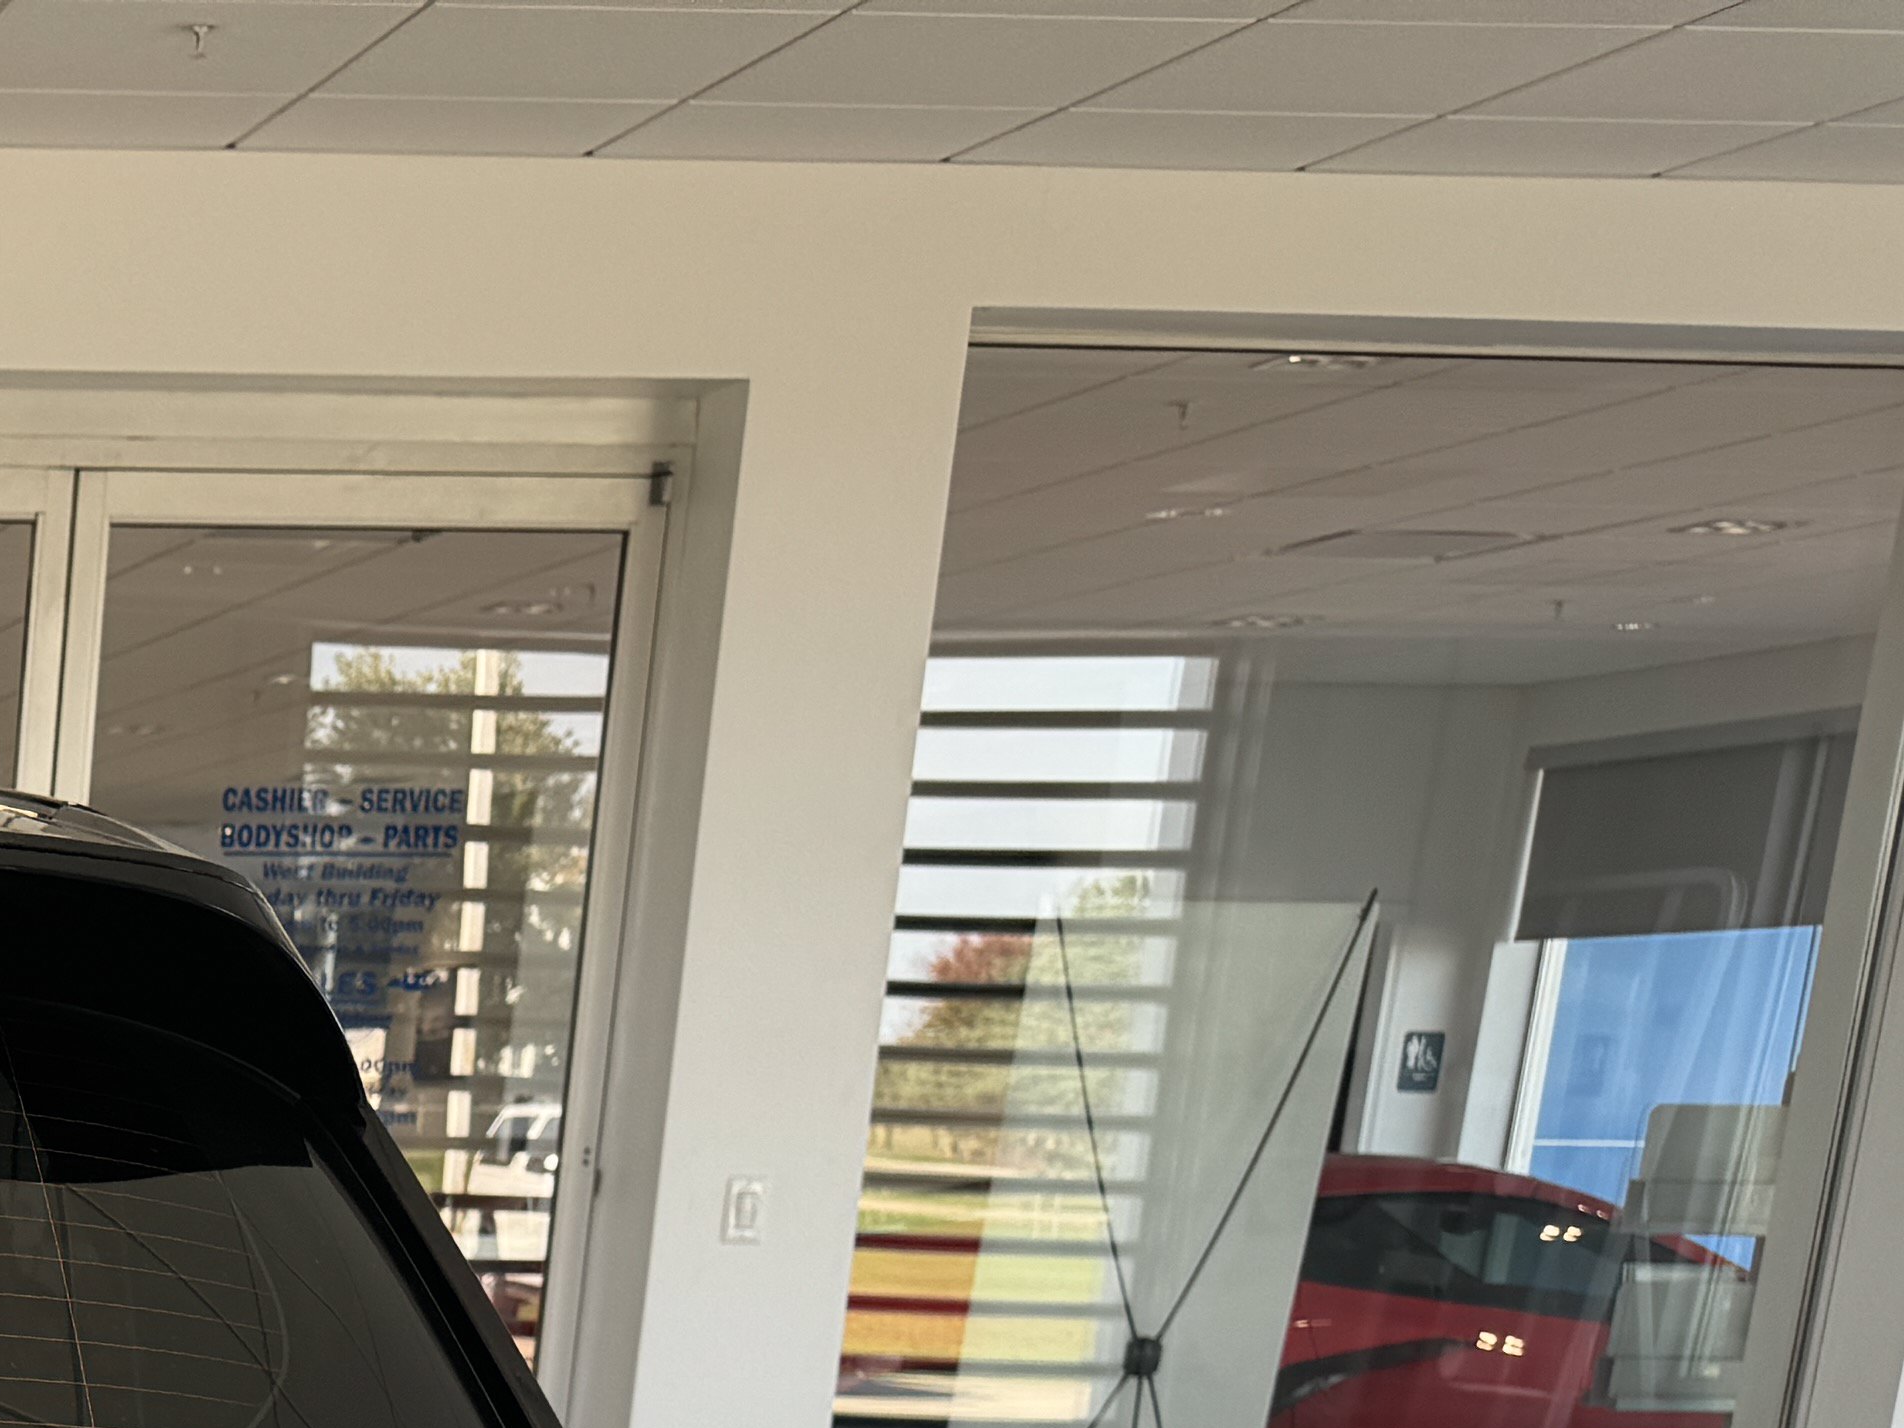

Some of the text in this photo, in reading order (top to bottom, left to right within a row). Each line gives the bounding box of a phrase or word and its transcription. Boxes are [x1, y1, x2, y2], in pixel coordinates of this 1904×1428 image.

[222, 786, 330, 813] CASHIER
[359, 788, 465, 814] SERVICE
[219, 824, 353, 849] BODYSHOP
[382, 824, 461, 850] PARTS
[368, 887, 442, 912] Friday
